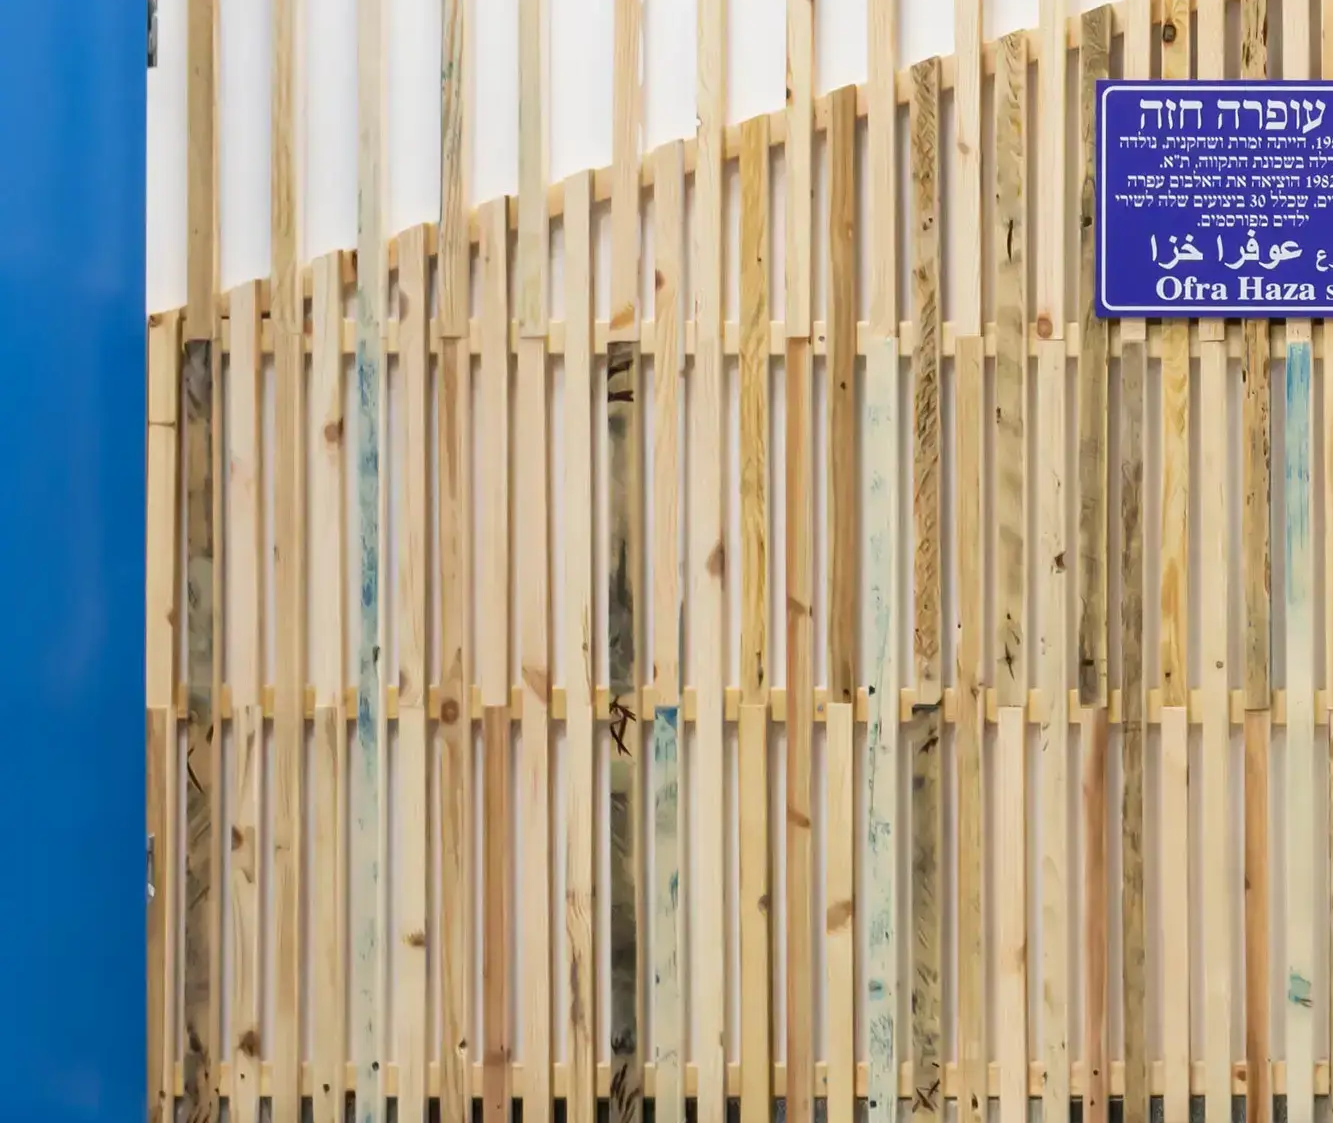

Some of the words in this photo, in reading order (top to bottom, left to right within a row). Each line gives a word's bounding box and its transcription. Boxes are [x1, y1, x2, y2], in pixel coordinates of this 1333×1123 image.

[1138, 98, 1204, 131] חזה
[1216, 98, 1327, 134] עופרה
[1119, 130, 1158, 149] נולדה
[1227, 136, 1263, 150] זמרת
[1266, 136, 1307, 150] הייתה
[1252, 155, 1305, 169] בשכונת
[1127, 175, 1166, 189] עפרה
[1169, 169, 1222, 189] האלבום
[1225, 175, 1247, 189] את
[1251, 175, 1301, 189] הוציאה
[1114, 189, 1154, 208] לשירי
[1158, 189, 1190, 208] שלה
[1193, 194, 1245, 209] ביצועים
[1249, 193, 1266, 208] 30
[1270, 189, 1309, 208] שכלל
[1196, 214, 1269, 228] מפורסמים.
[1273, 209, 1310, 227] ילדים
[1150, 233, 1204, 270] خزا
[1216, 229, 1303, 270] عوفرا
[1155, 275, 1229, 301] Ofra
[1237, 276, 1317, 301] Haza
